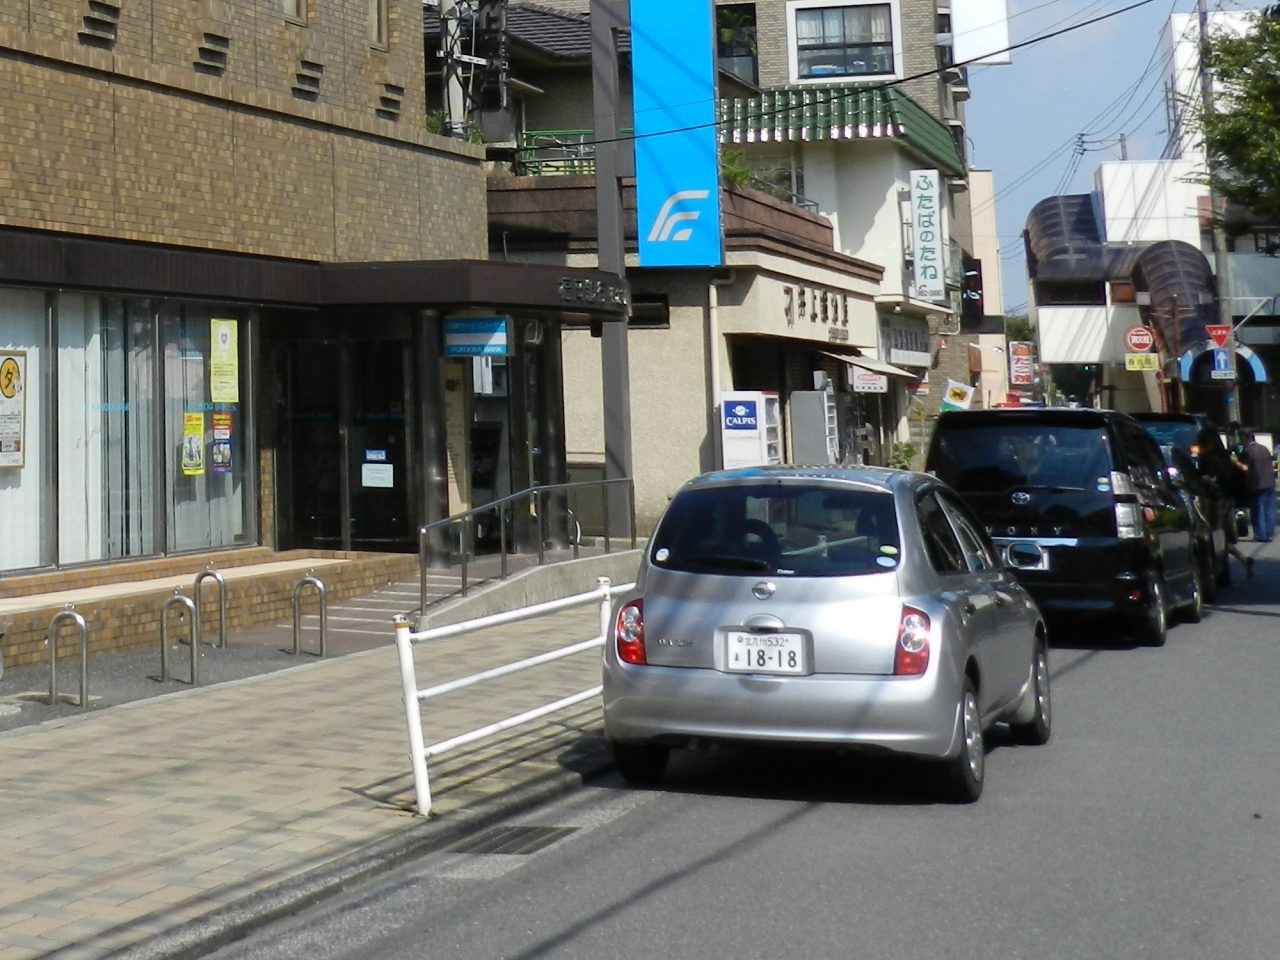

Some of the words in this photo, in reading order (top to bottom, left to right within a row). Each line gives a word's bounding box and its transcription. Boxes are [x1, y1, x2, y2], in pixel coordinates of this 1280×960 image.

[916, 175, 937, 280] ふたばのたね
[726, 416, 756, 426] CALPIS
[984, 526, 1062, 536] VOXY
[747, 648, 797, 668] 18-18
